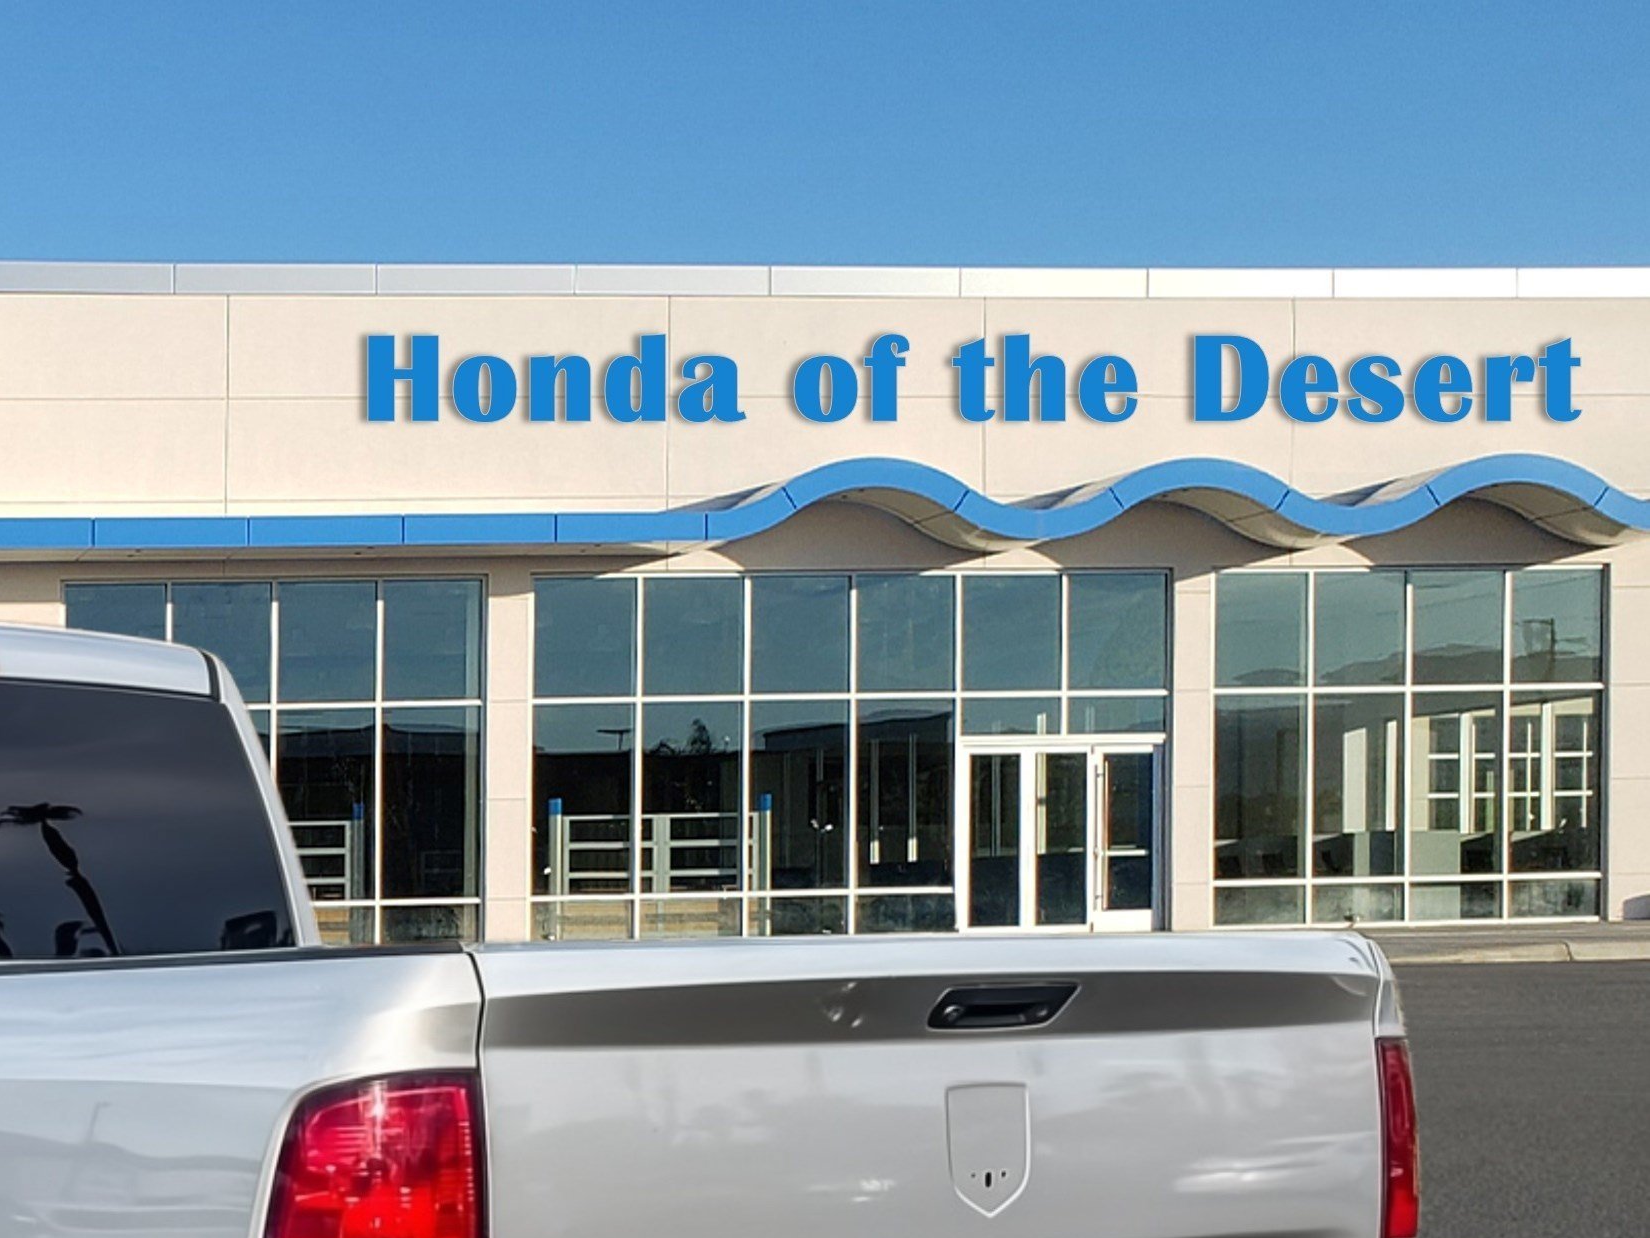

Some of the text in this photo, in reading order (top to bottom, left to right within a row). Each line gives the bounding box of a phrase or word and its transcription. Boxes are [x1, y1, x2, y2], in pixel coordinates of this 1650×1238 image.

[365, 332, 1583, 426] Honda of the Desert
